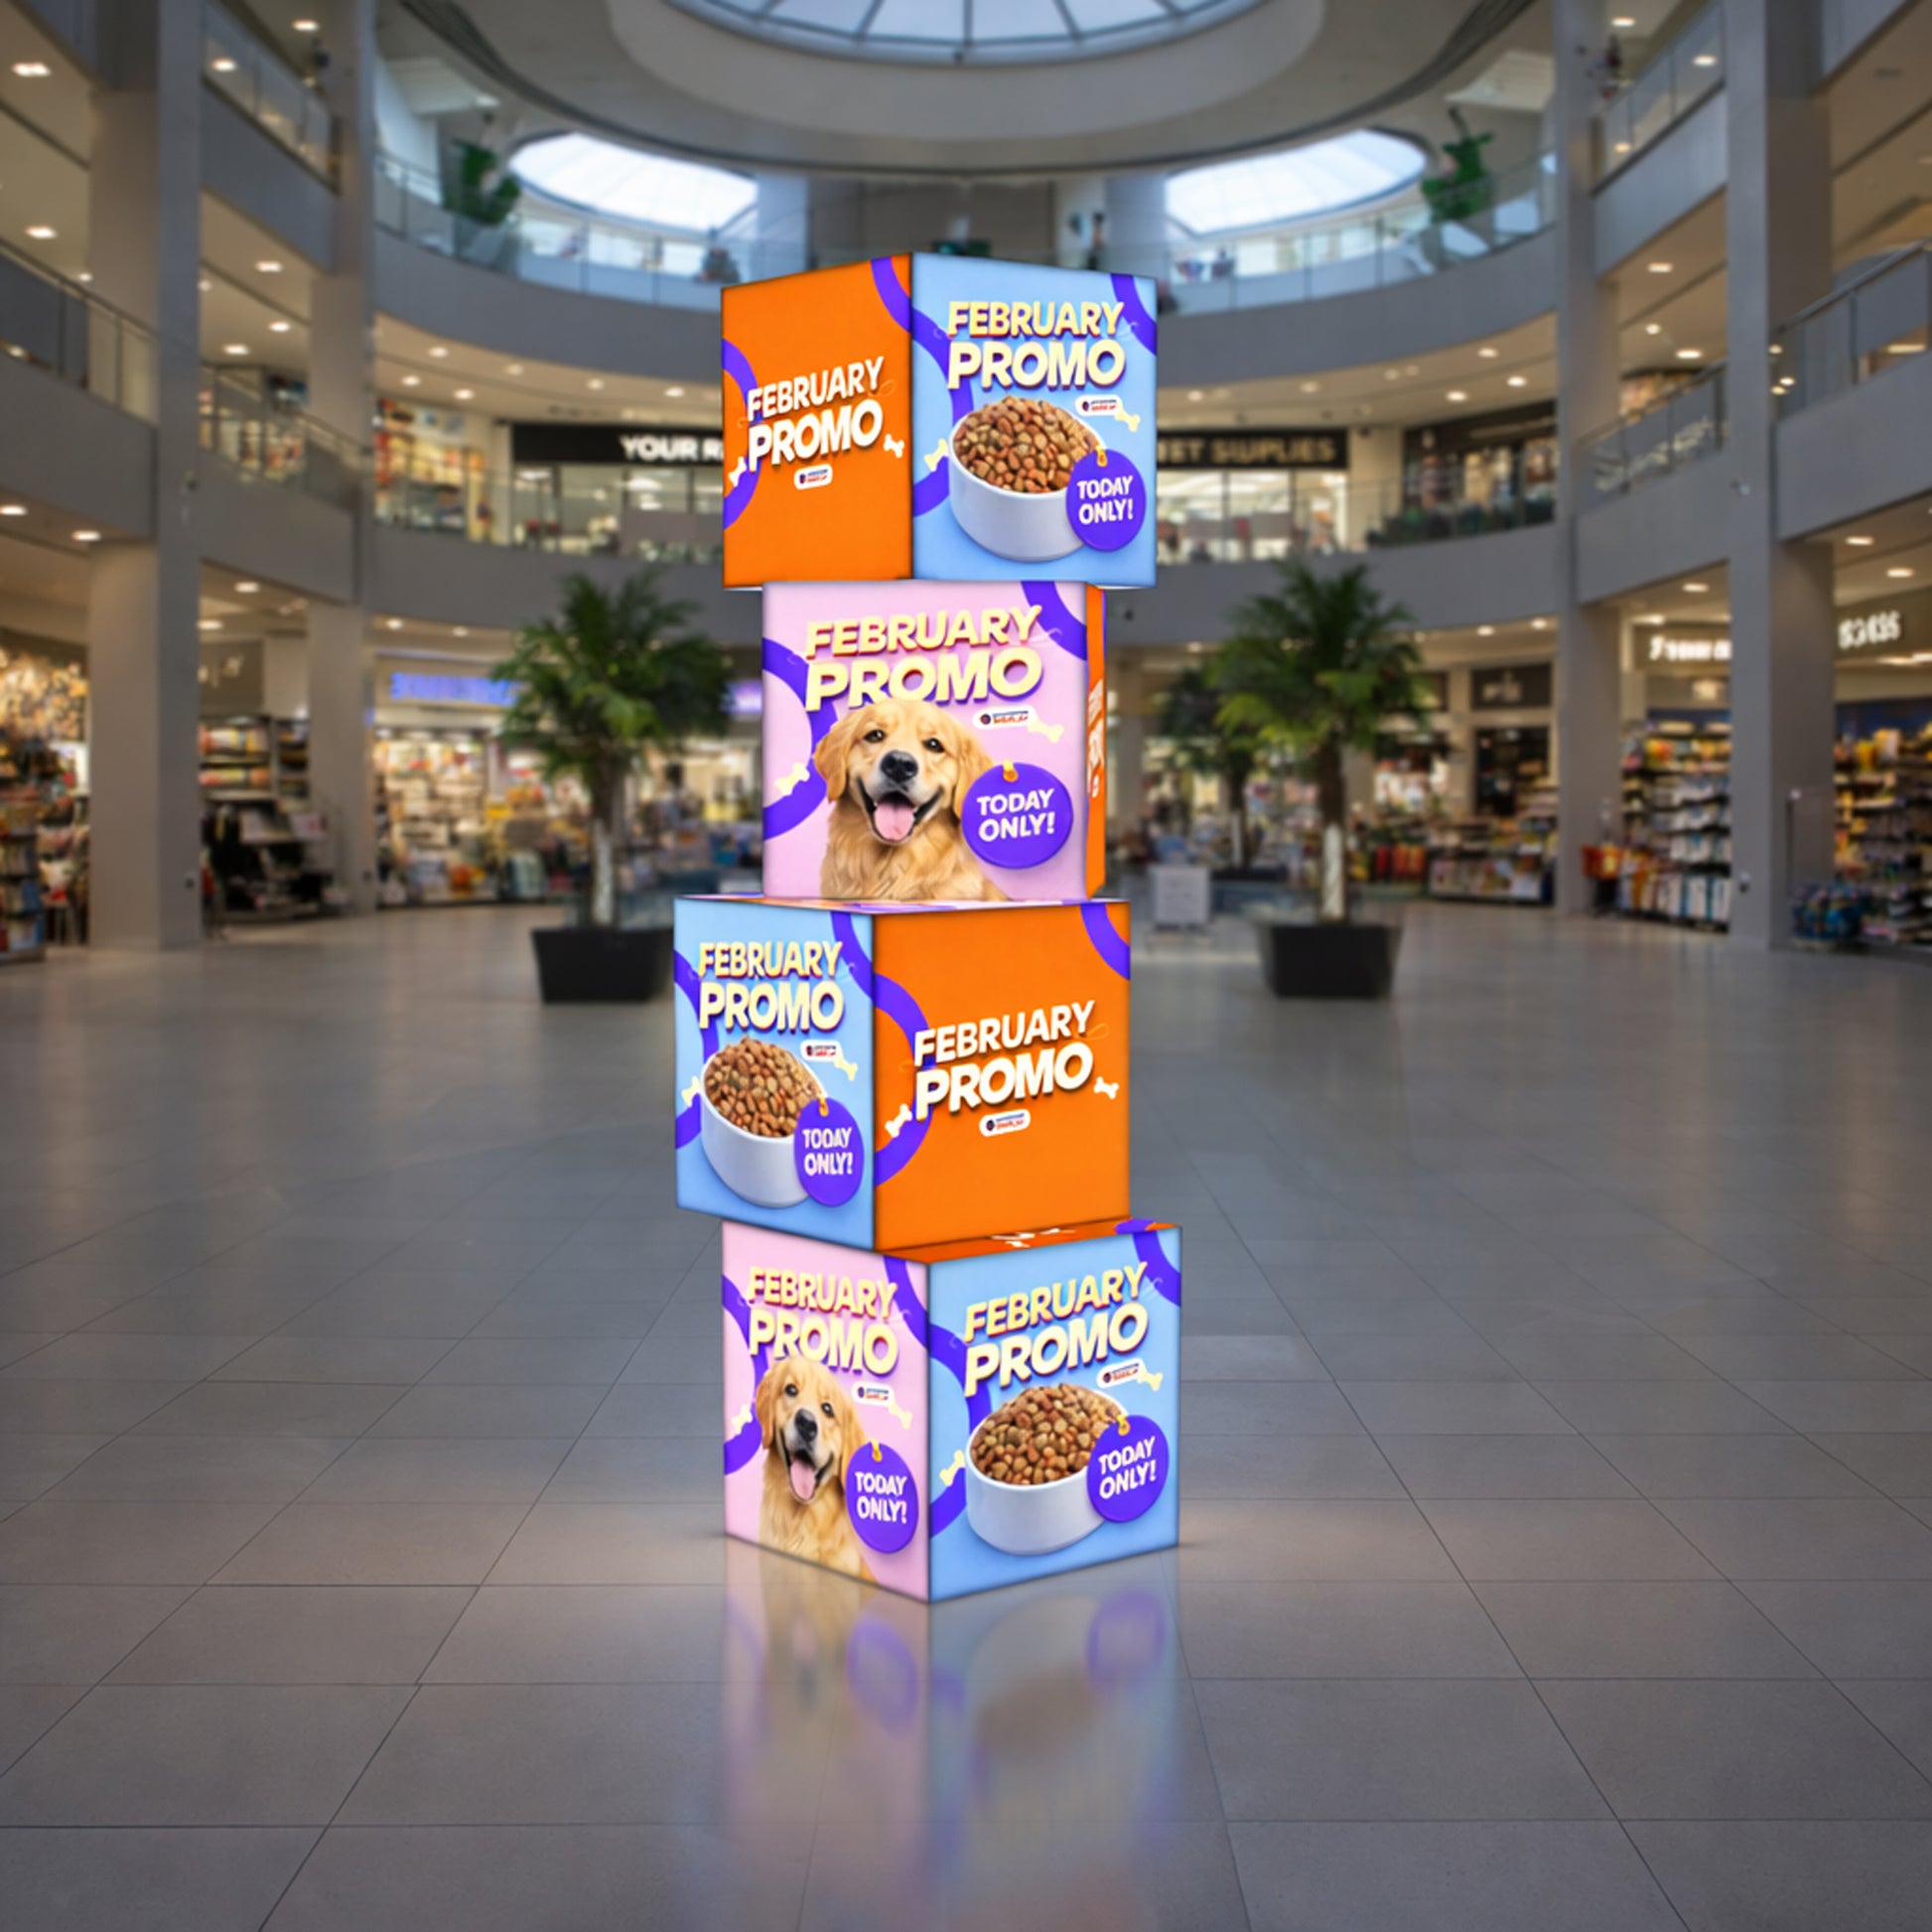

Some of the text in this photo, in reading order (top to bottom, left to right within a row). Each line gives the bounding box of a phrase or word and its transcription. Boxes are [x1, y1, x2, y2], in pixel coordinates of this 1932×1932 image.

[948, 301, 1125, 339] FEBRUARY
[948, 340, 1126, 390] PROMO
[747, 356, 885, 422] FEBRUARY
[620, 435, 698, 461] YOUR
[748, 399, 884, 472] PROMO
[1077, 476, 1134, 501] TODAY
[1078, 497, 1134, 526] ONLY!
[806, 606, 1042, 659] FEBRUARY
[805, 647, 1042, 712] PROMO
[977, 788, 1054, 816] TODAY
[979, 812, 1055, 842] ONLY!
[698, 941, 843, 978] FEBRUARY
[699, 980, 845, 1031] PROMO
[913, 1000, 1095, 1067] FEBRUARY
[915, 1041, 1094, 1120] PROMO
[802, 1127, 853, 1150] TODAY
[804, 1152, 854, 1176] ONLY!
[746, 1267, 897, 1318] FEBRUARY
[964, 1262, 1148, 1342] FEBRUARY
[749, 1308, 898, 1375] PROMO
[964, 1302, 1149, 1397] PROMO
[1098, 1437, 1156, 1473] TODAY
[855, 1470, 907, 1496] TODAY
[1099, 1459, 1157, 1500] ONLY!
[857, 1497, 907, 1524] ONLY!
